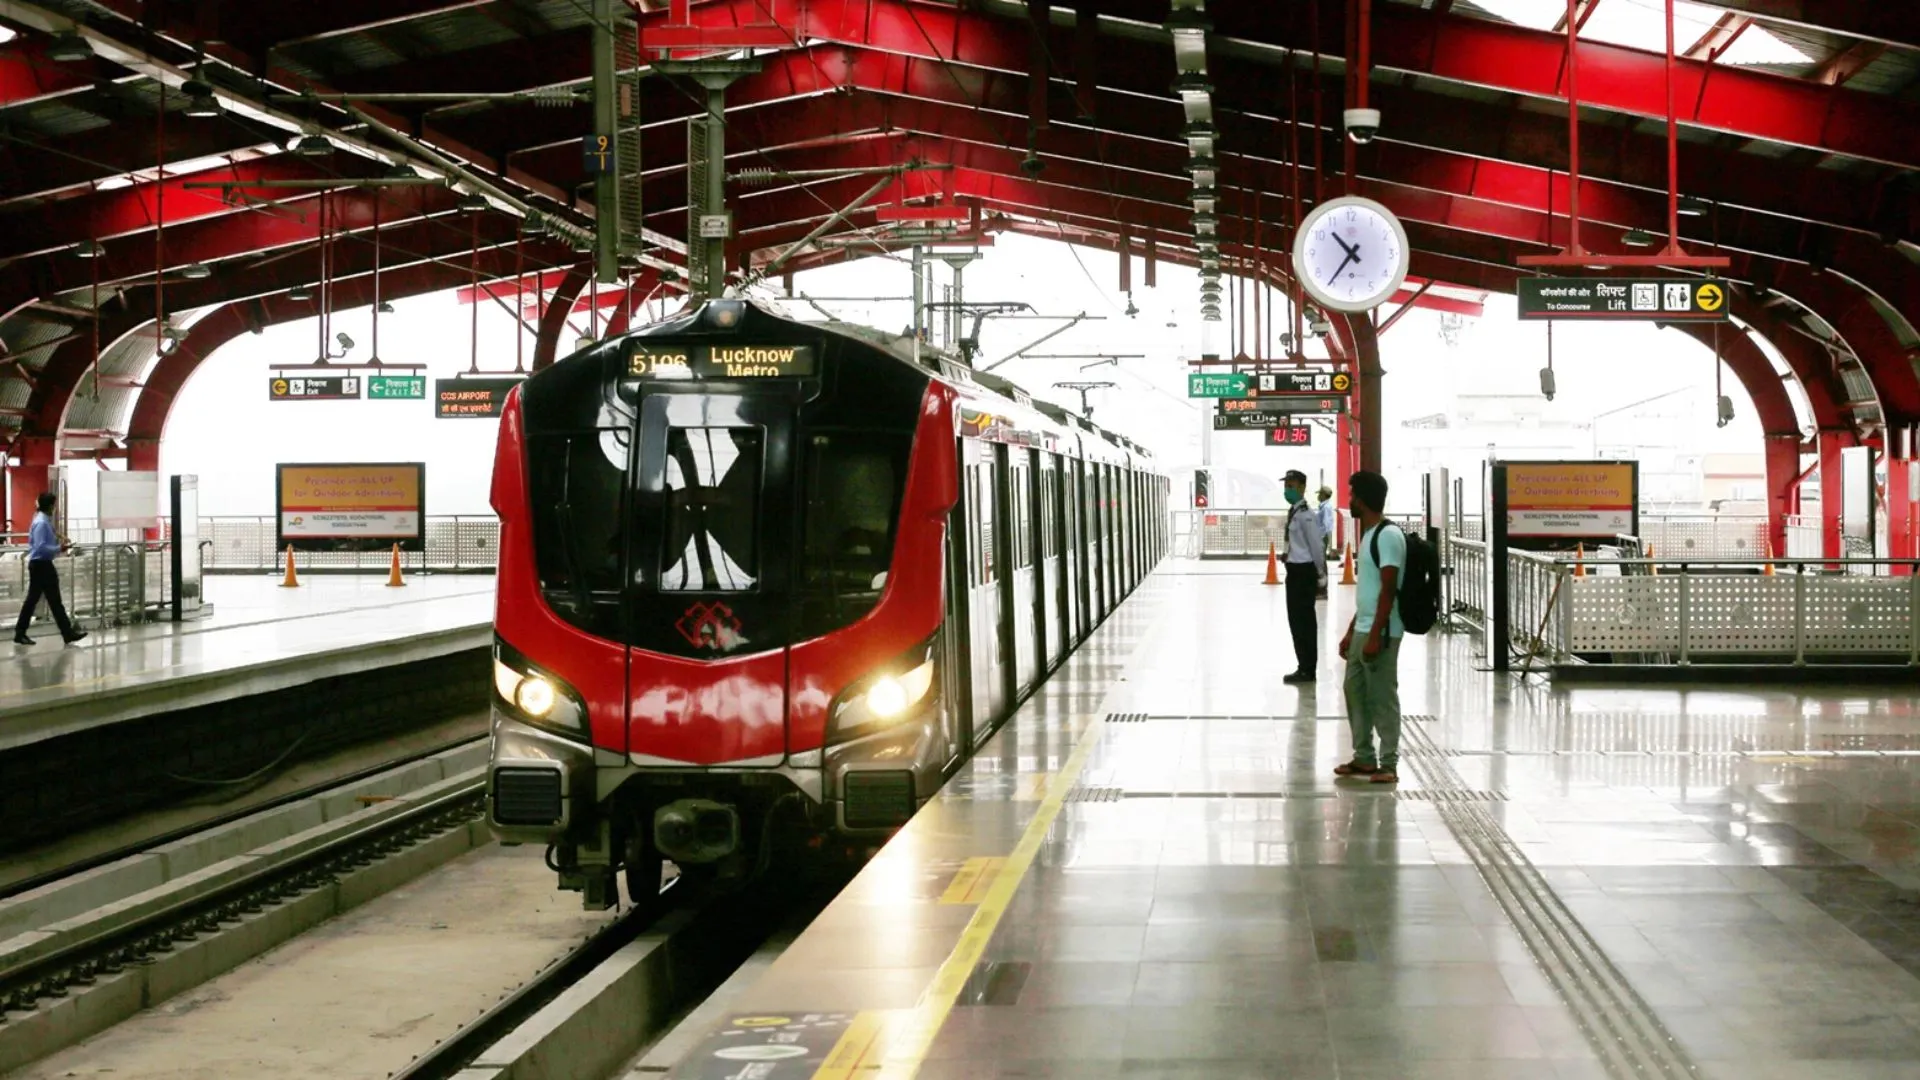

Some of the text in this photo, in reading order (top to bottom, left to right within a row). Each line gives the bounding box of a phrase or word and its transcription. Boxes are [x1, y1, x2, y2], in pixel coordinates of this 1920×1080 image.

[597, 135, 608, 152] 9
[1328, 217, 1337, 227] 11
[1346, 211, 1357, 222] 12
[1315, 230, 1325, 241] 10
[1382, 230, 1389, 241] 2
[1309, 249, 1316, 260] 9
[1388, 248, 1394, 260] 3
[1315, 267, 1322, 278] 8
[1382, 268, 1389, 278] 4
[1368, 281, 1374, 291] 5
[1596, 283, 1626, 297] लिफ्ट
[1607, 299, 1626, 310] Lift
[711, 346, 794, 363] Lucknow
[727, 364, 780, 377] Metro
[385, 388, 409, 396] EXIT
[457, 391, 491, 400] AIRPORT
[1206, 387, 1230, 395] EXIT
